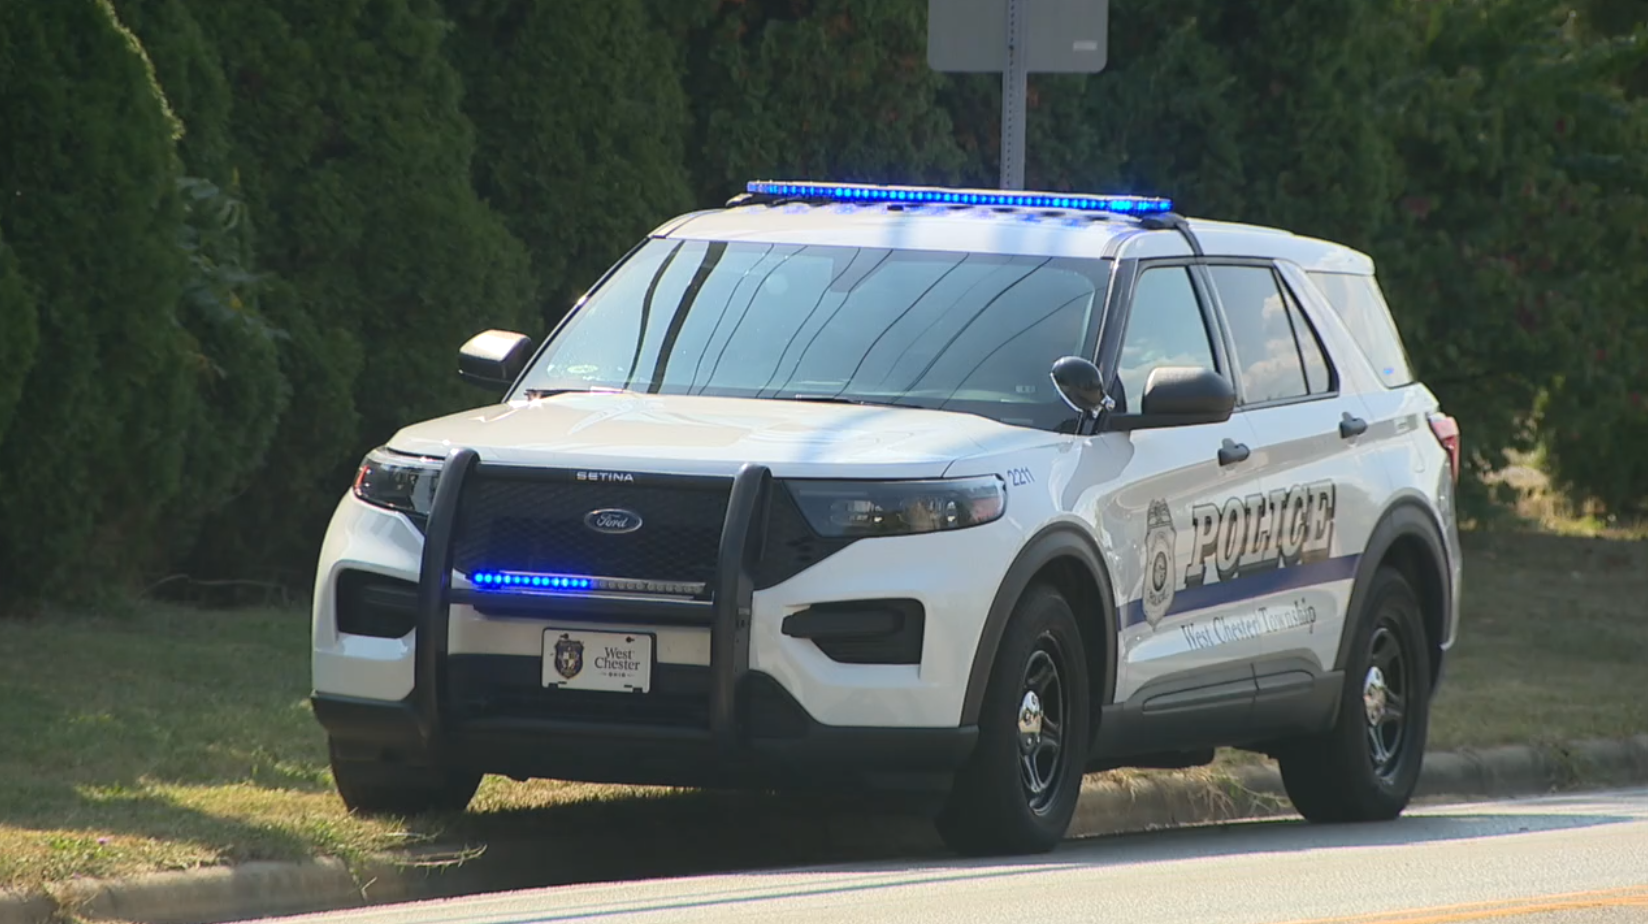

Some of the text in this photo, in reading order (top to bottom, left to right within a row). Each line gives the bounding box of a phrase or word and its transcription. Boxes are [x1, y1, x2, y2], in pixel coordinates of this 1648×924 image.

[576, 471, 634, 482] SETINA
[1007, 466, 1035, 486] 2211
[597, 514, 629, 528] Ford
[1185, 479, 1336, 588] POLICE
[1180, 597, 1317, 650] West Chester Township
[604, 647, 633, 660] West
[594, 656, 641, 671] Chester
